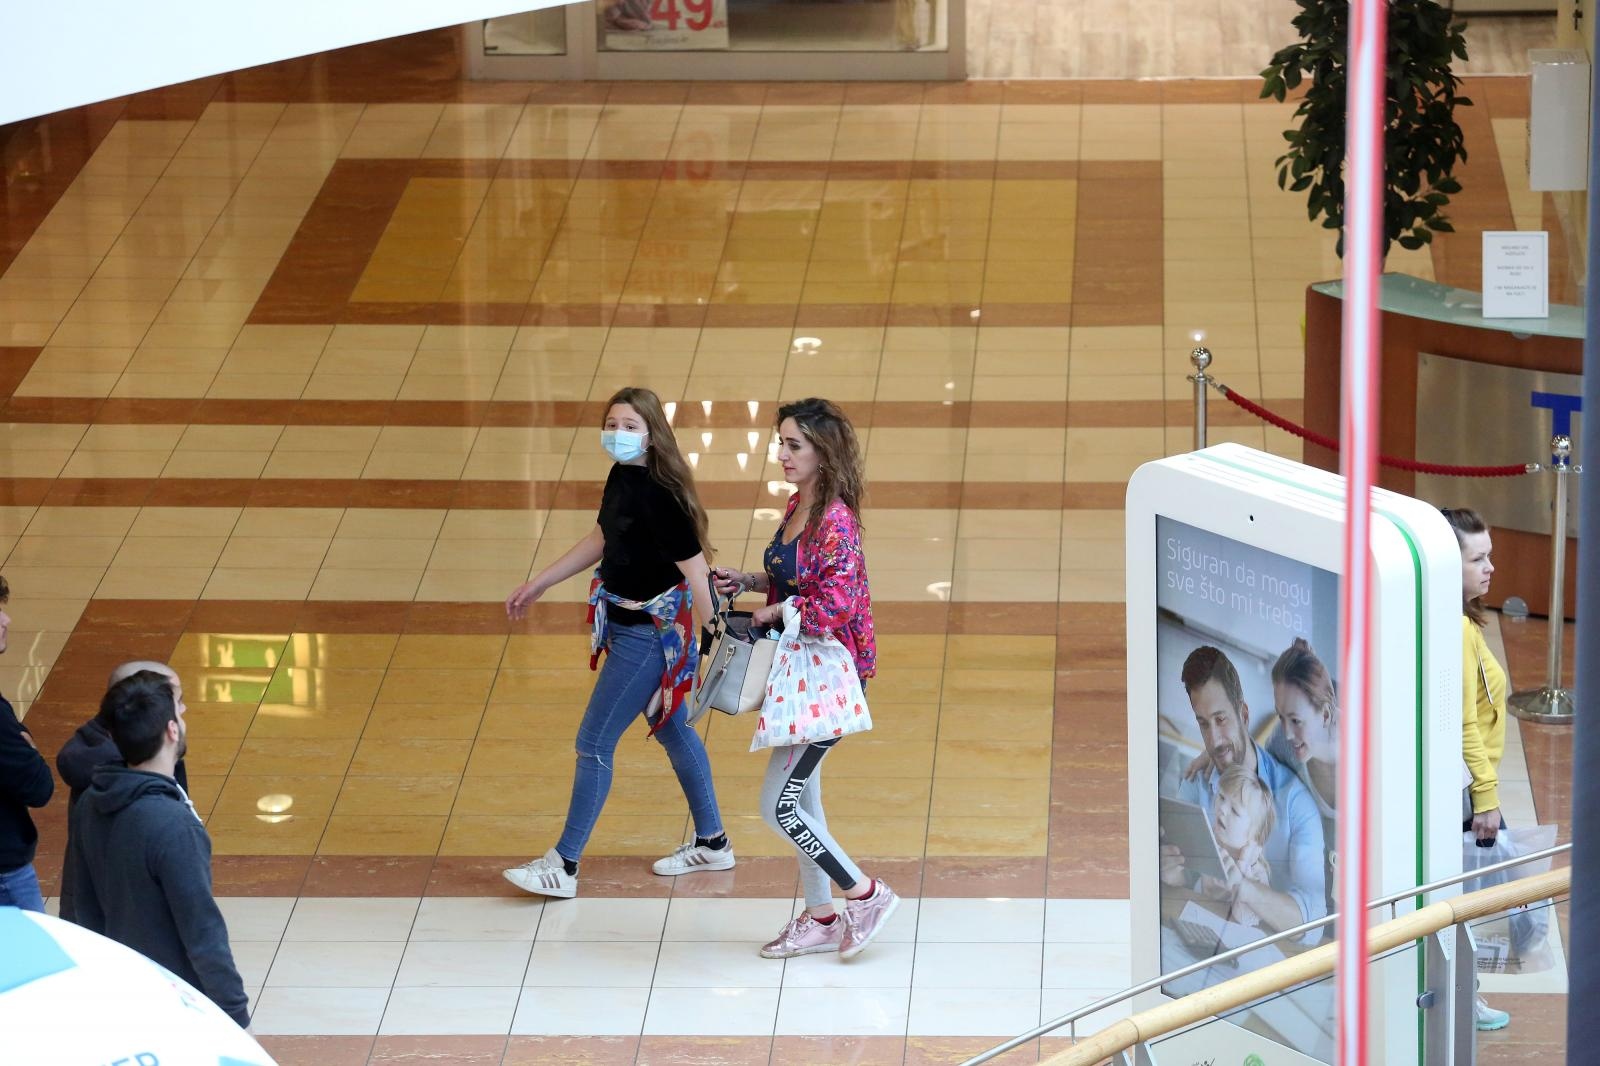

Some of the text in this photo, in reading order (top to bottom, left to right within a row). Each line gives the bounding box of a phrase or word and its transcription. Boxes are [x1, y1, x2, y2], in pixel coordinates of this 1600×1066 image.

[650, 0, 714, 31] 49
[1167, 538, 1310, 608] Siguran da mogu
[1168, 571, 1308, 633] sve što mi treba.
[778, 777, 826, 859] TAKE THE RISK
